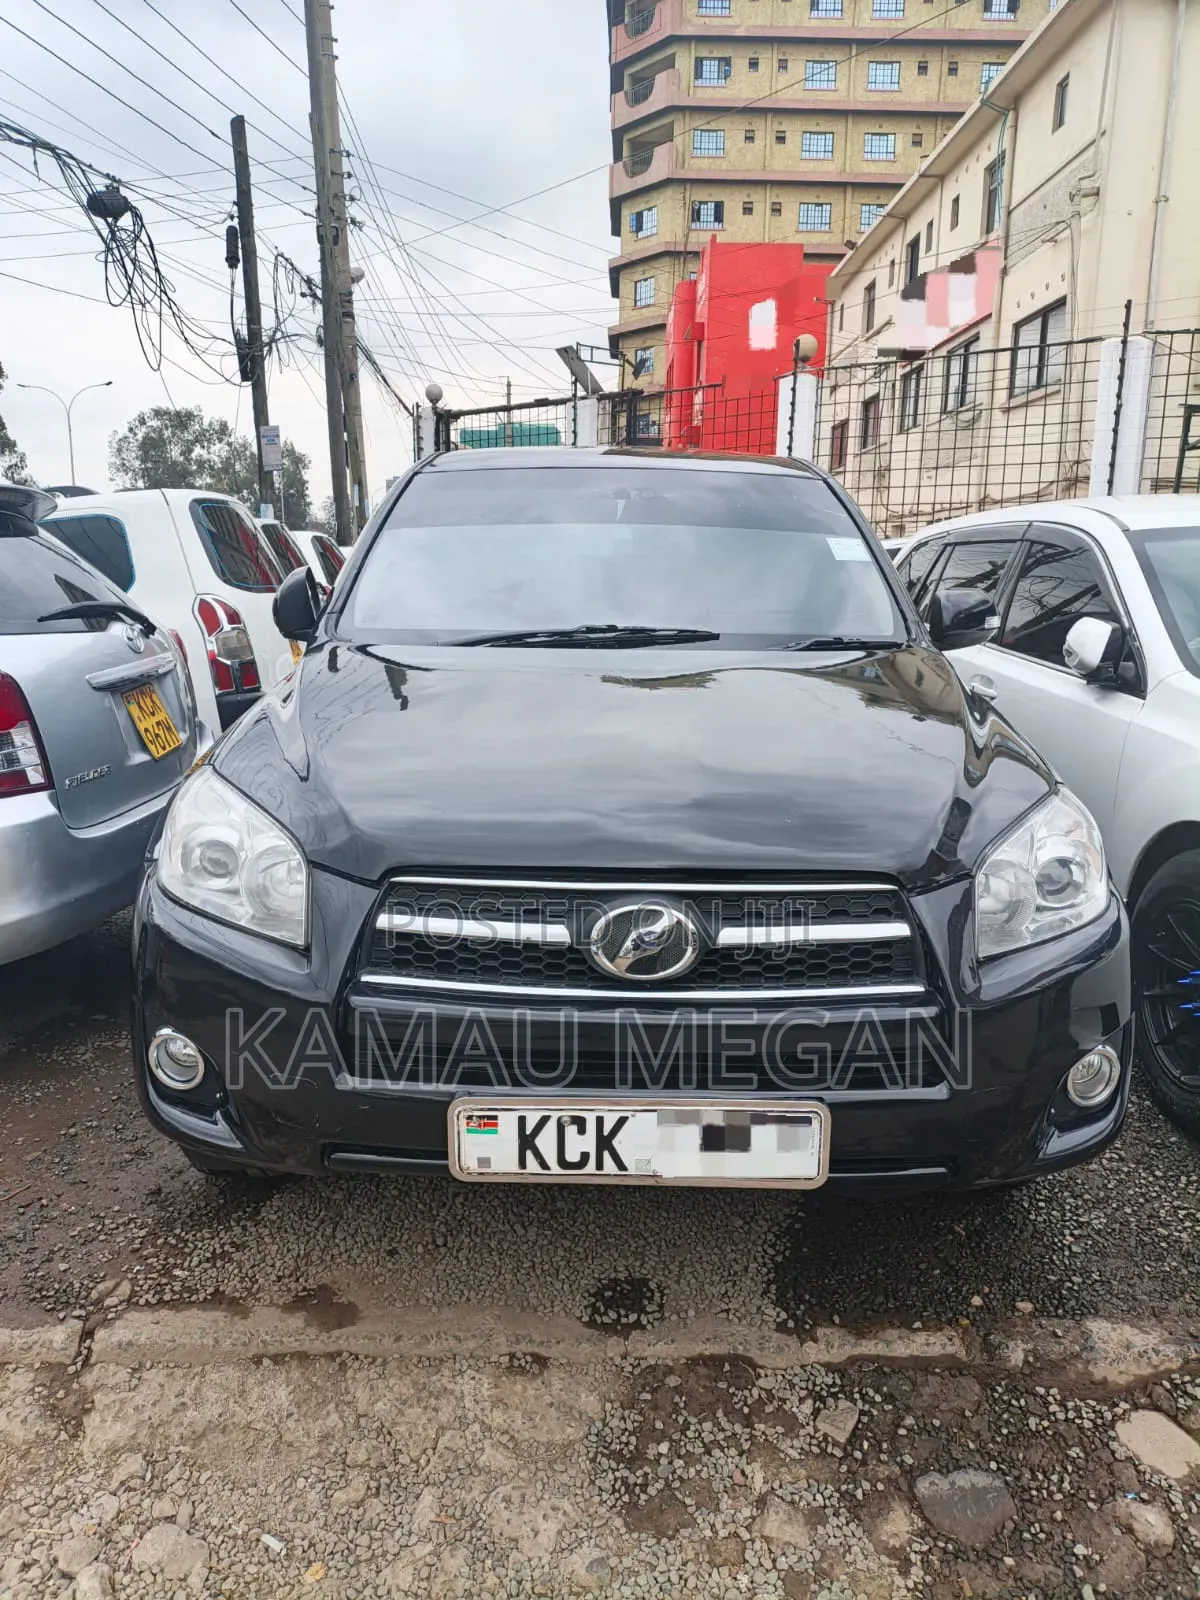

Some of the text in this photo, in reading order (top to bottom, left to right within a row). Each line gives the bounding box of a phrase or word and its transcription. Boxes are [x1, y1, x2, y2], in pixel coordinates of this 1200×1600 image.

[131, 686, 163, 721] KCK
[65, 764, 112, 790] FIELDER
[517, 1114, 630, 1172] KCK
